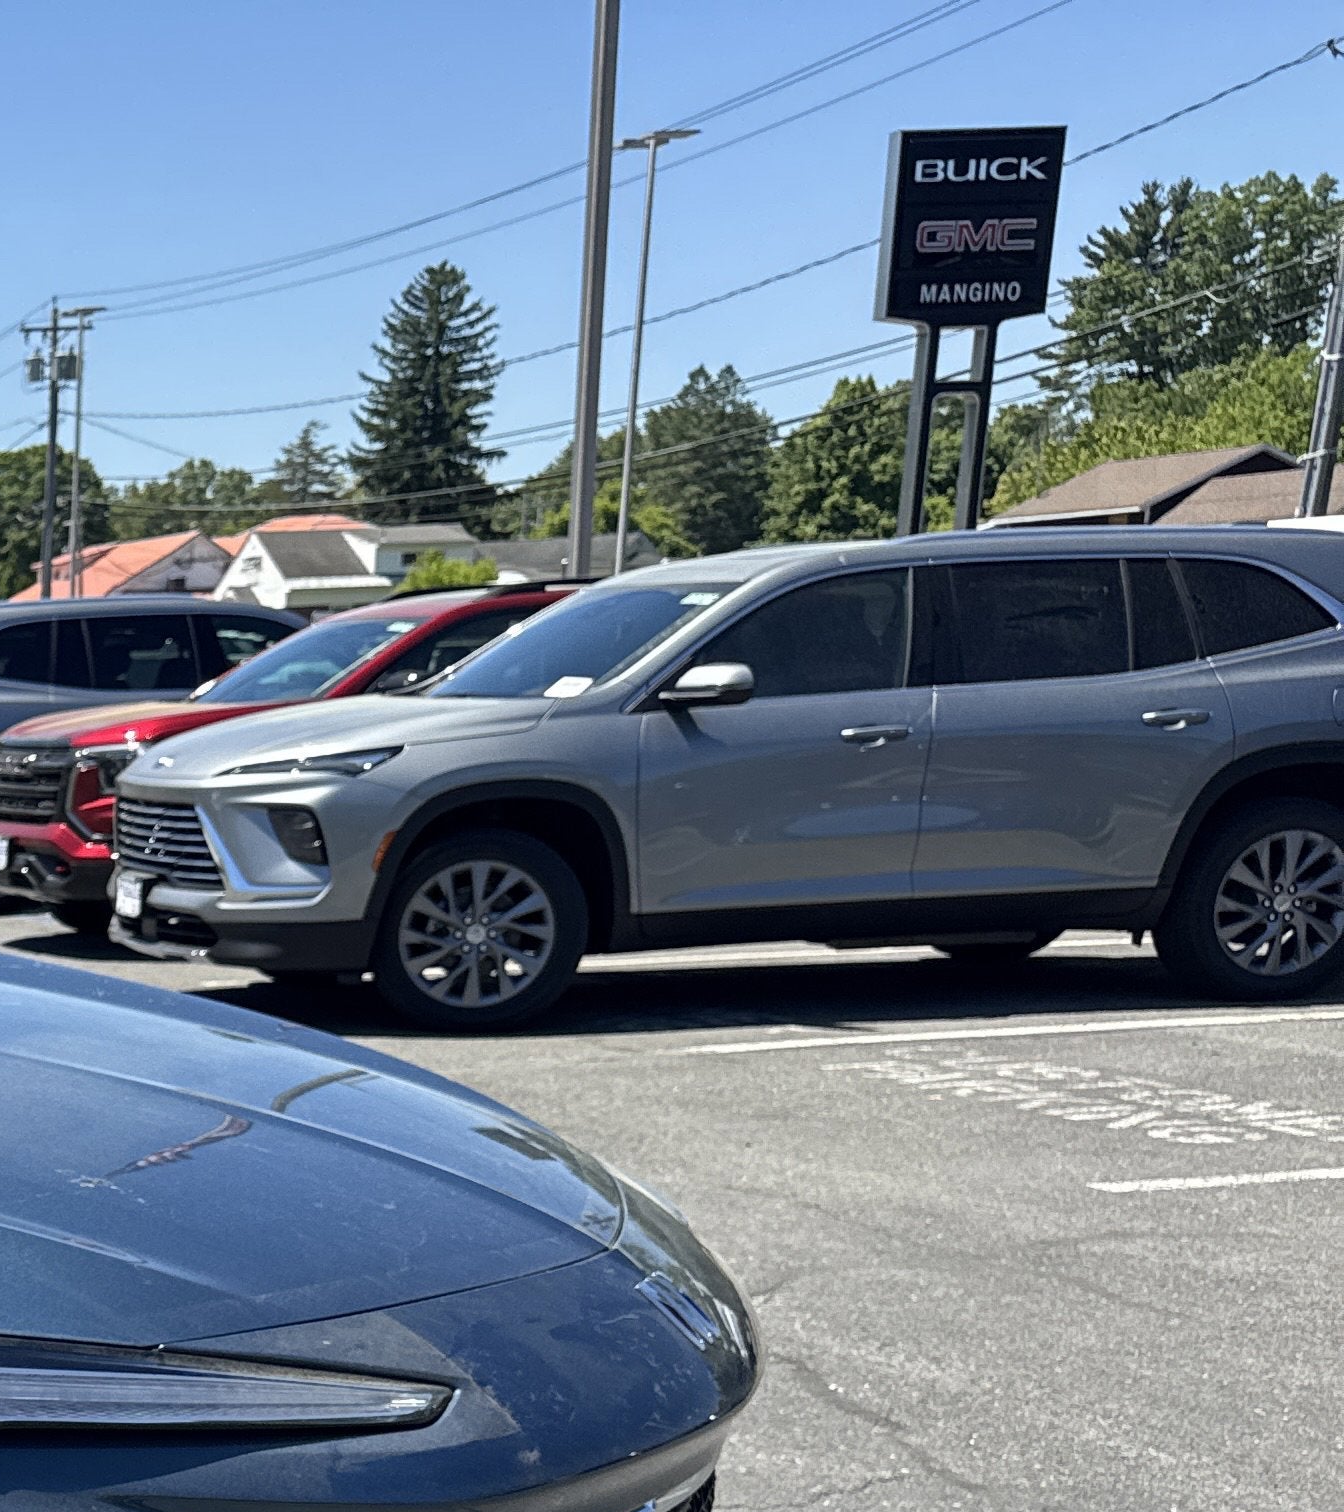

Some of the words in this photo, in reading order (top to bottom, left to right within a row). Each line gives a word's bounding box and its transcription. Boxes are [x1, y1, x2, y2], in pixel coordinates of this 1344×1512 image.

[914, 156, 1048, 183] BUICK
[916, 217, 1038, 253] GMC
[919, 281, 1021, 304] MANGINO
